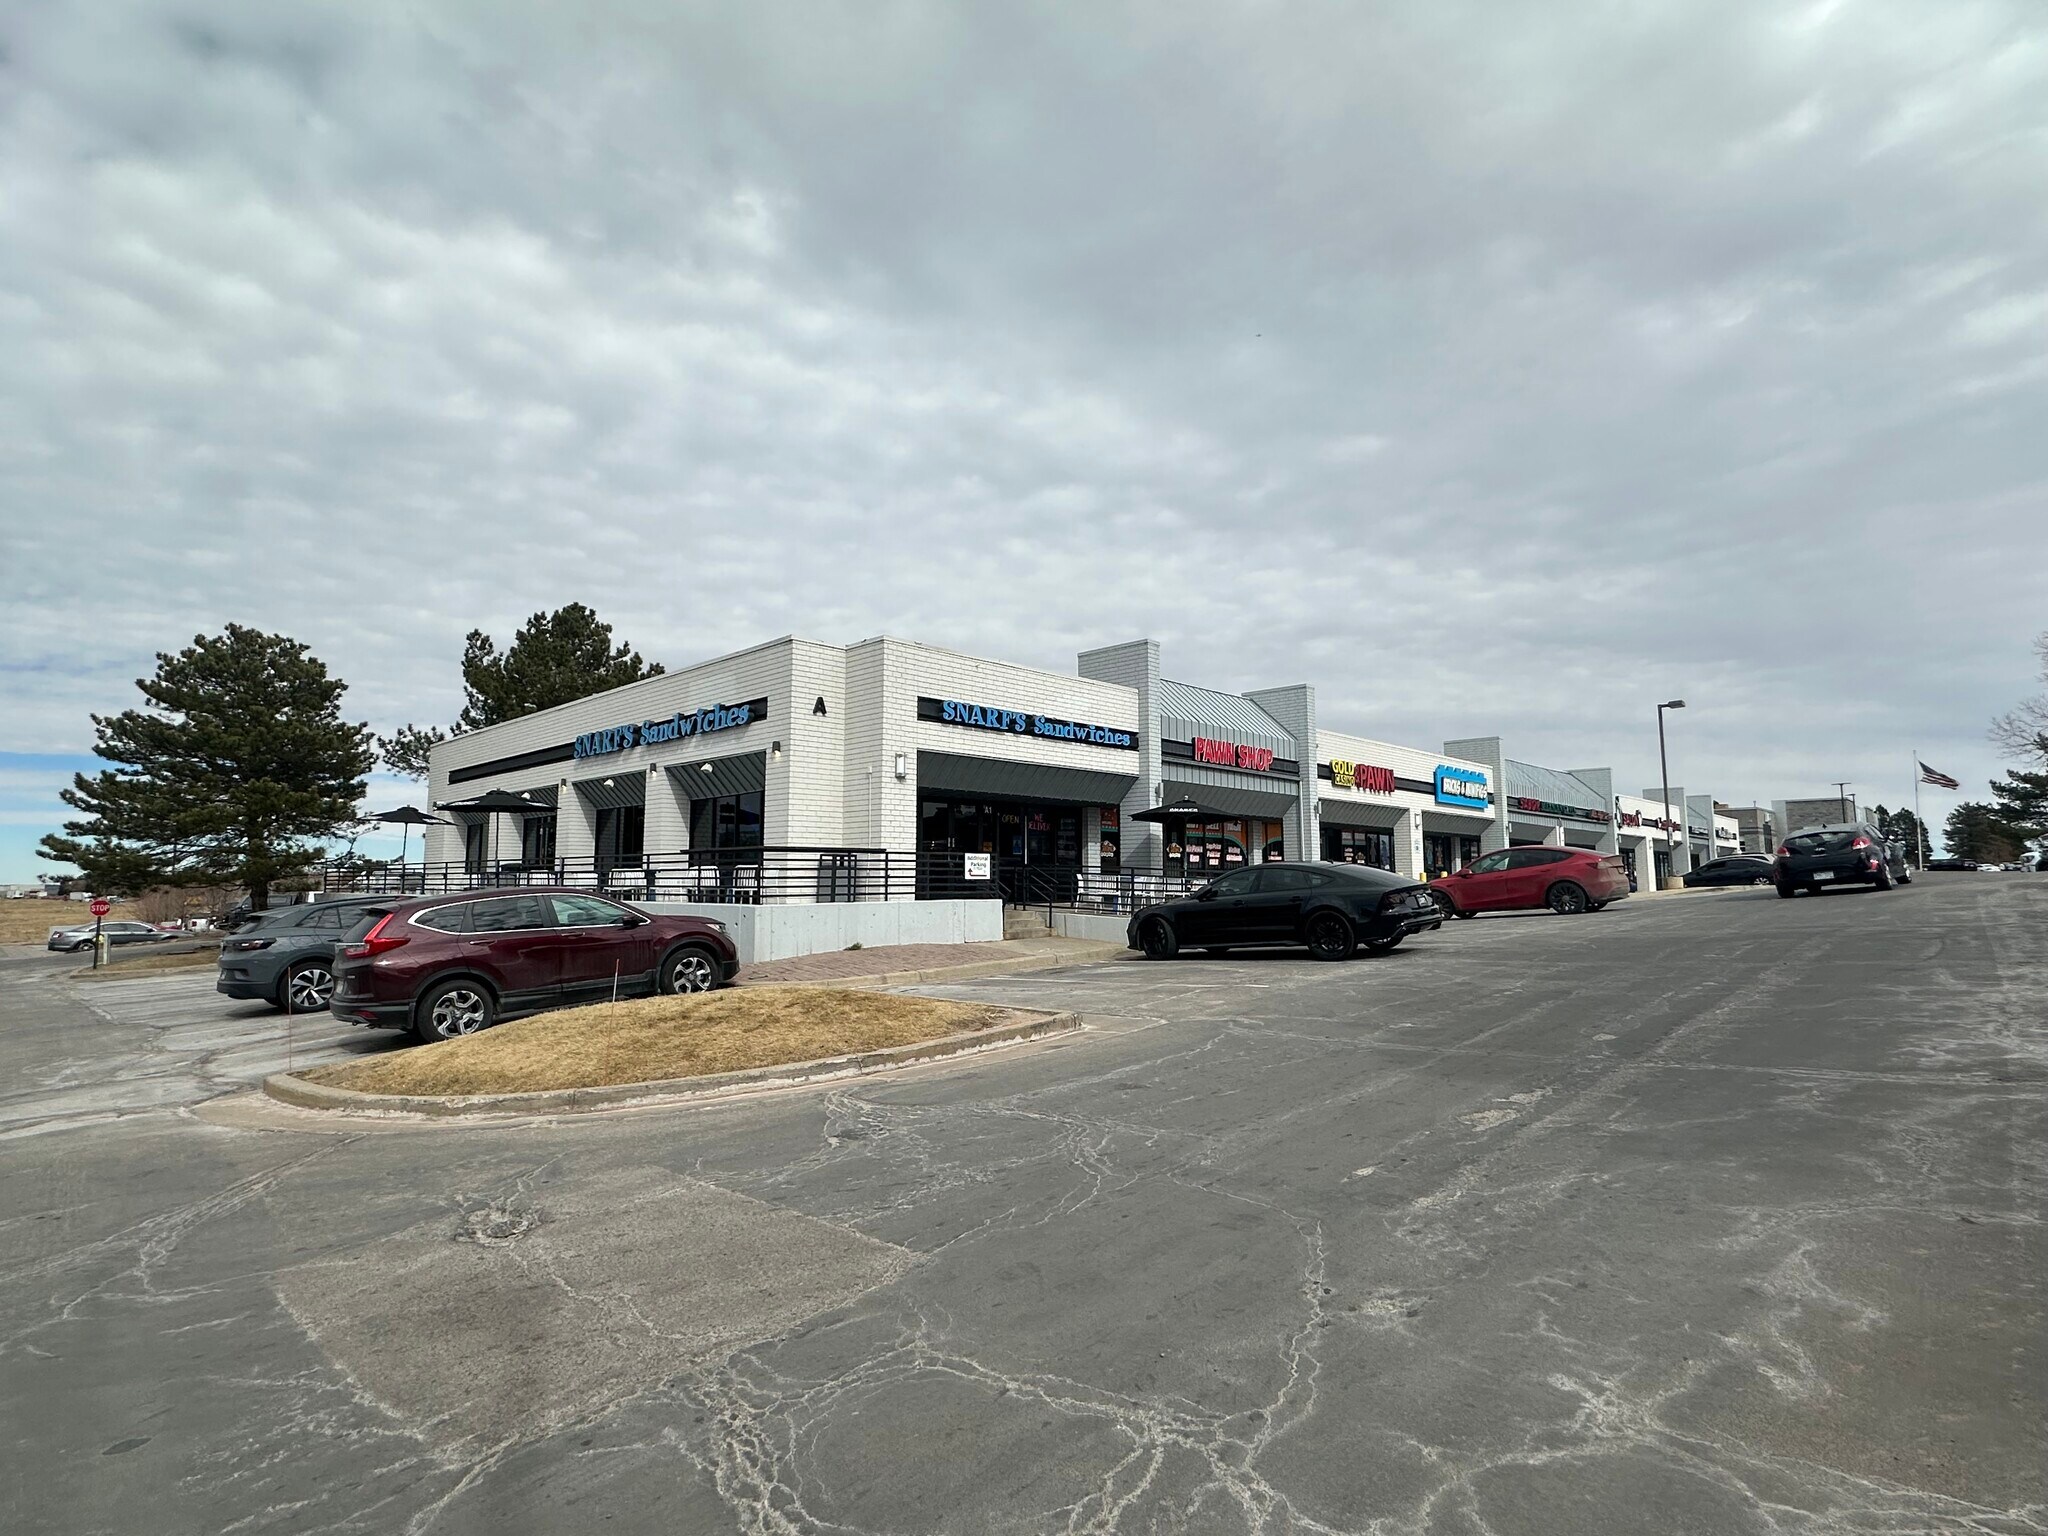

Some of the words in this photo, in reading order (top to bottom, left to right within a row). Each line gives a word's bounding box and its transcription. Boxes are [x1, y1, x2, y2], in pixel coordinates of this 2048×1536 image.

[813, 697, 827, 714] A
[574, 723, 634, 759] SNARF'S
[640, 703, 750, 746] Sandwiches
[943, 700, 1027, 732] SNARF'S
[1033, 715, 1131, 746] Sandwiches
[1195, 736, 1236, 766] PAWN
[1238, 744, 1273, 771] SHOP
[1332, 759, 1355, 776] GOLD
[1359, 764, 1395, 792] PAWN
[1001, 814, 1020, 824] OPEN
[91, 904, 110, 912] STOP
